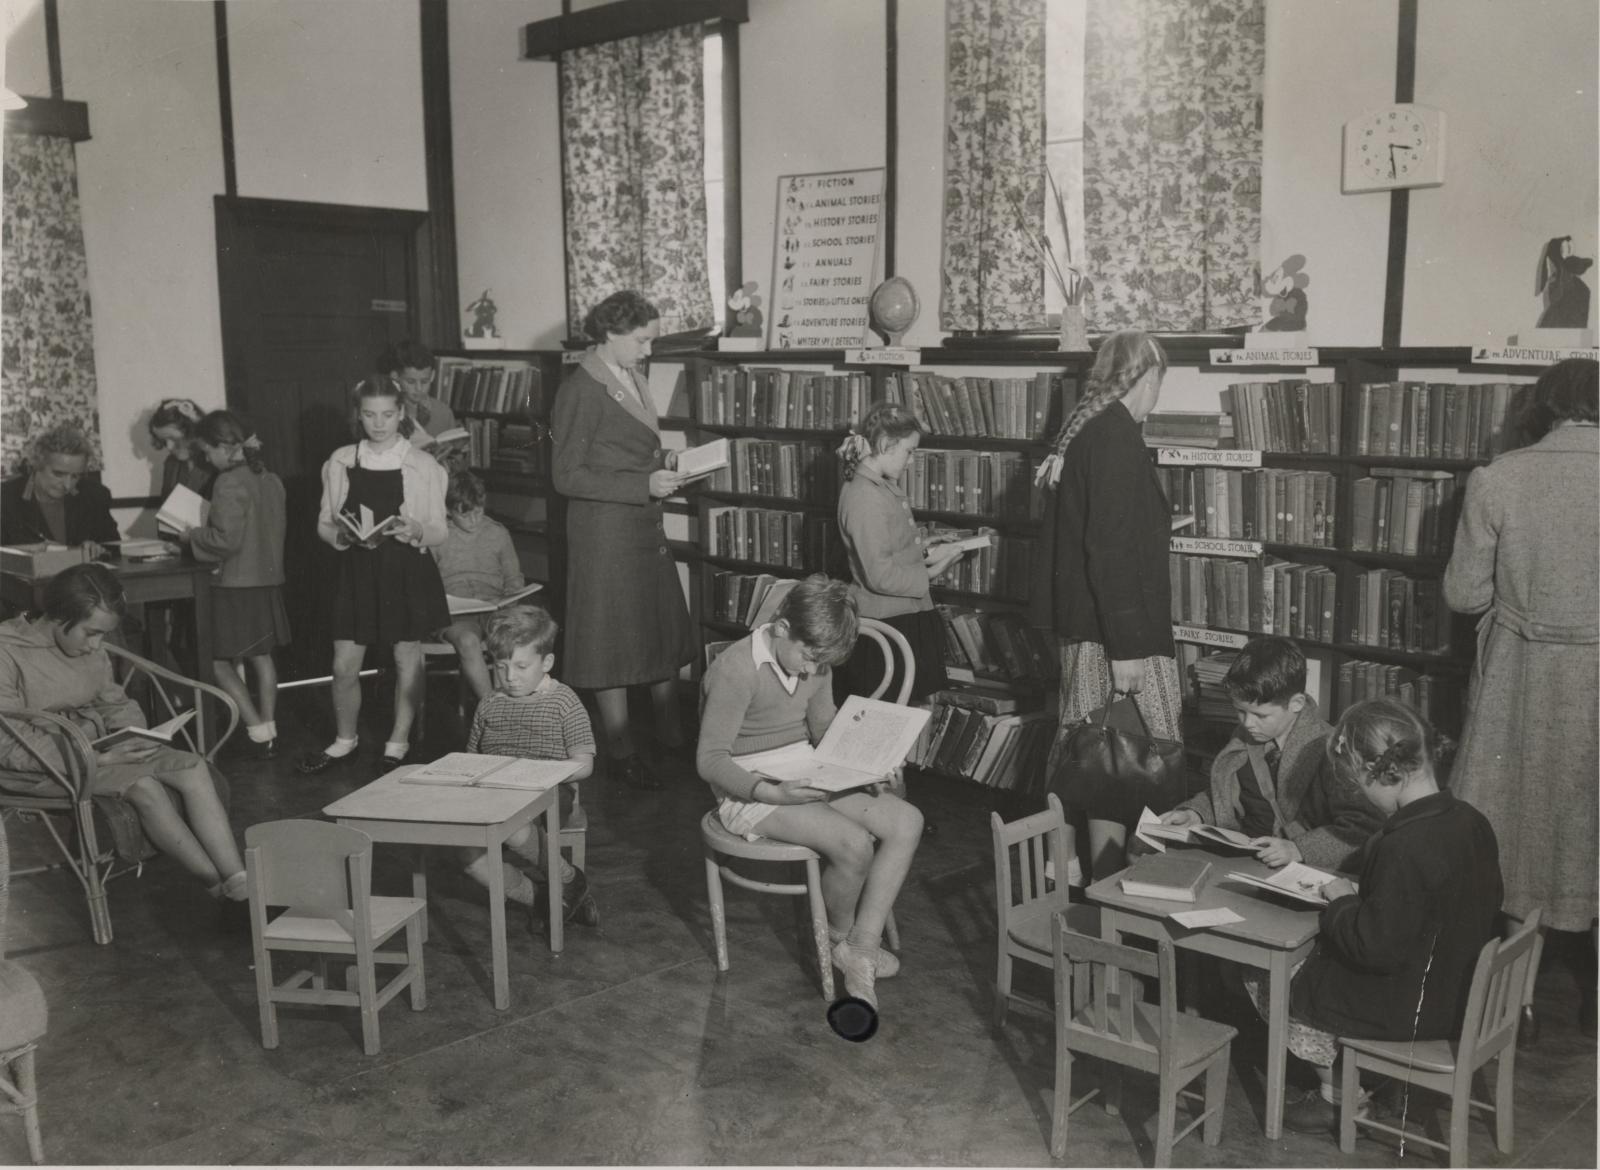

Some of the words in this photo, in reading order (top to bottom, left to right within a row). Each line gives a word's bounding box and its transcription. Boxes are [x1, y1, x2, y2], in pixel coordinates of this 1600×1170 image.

[817, 177, 855, 188] FICTION
[815, 198, 847, 208] ANIMAL
[850, 194, 880, 206] STORIES
[814, 217, 846, 227] HISTORY
[848, 214, 878, 225] STORIES
[812, 237, 843, 247] SCHOOL
[846, 235, 875, 245] STORIES
[815, 257, 852, 267] ANNUALS
[809, 278, 829, 287] FAIRY
[833, 276, 862, 286] STORIES
[801, 318, 838, 327] ADVENTURE
[839, 317, 866, 327] STORIES
[879, 351, 904, 361] FICTION
[1245, 351, 1280, 361] ANIMAL
[1283, 351, 1313, 361] STORIES
[1503, 348, 1560, 363] ADVENTURE
[1191, 452, 1223, 462] HISTORY
[1226, 452, 1254, 462] STORIES
[1195, 541, 1226, 551] SCHOOL
[1180, 629, 1200, 640] FAIRY
[1205, 632, 1234, 644] STORIES
